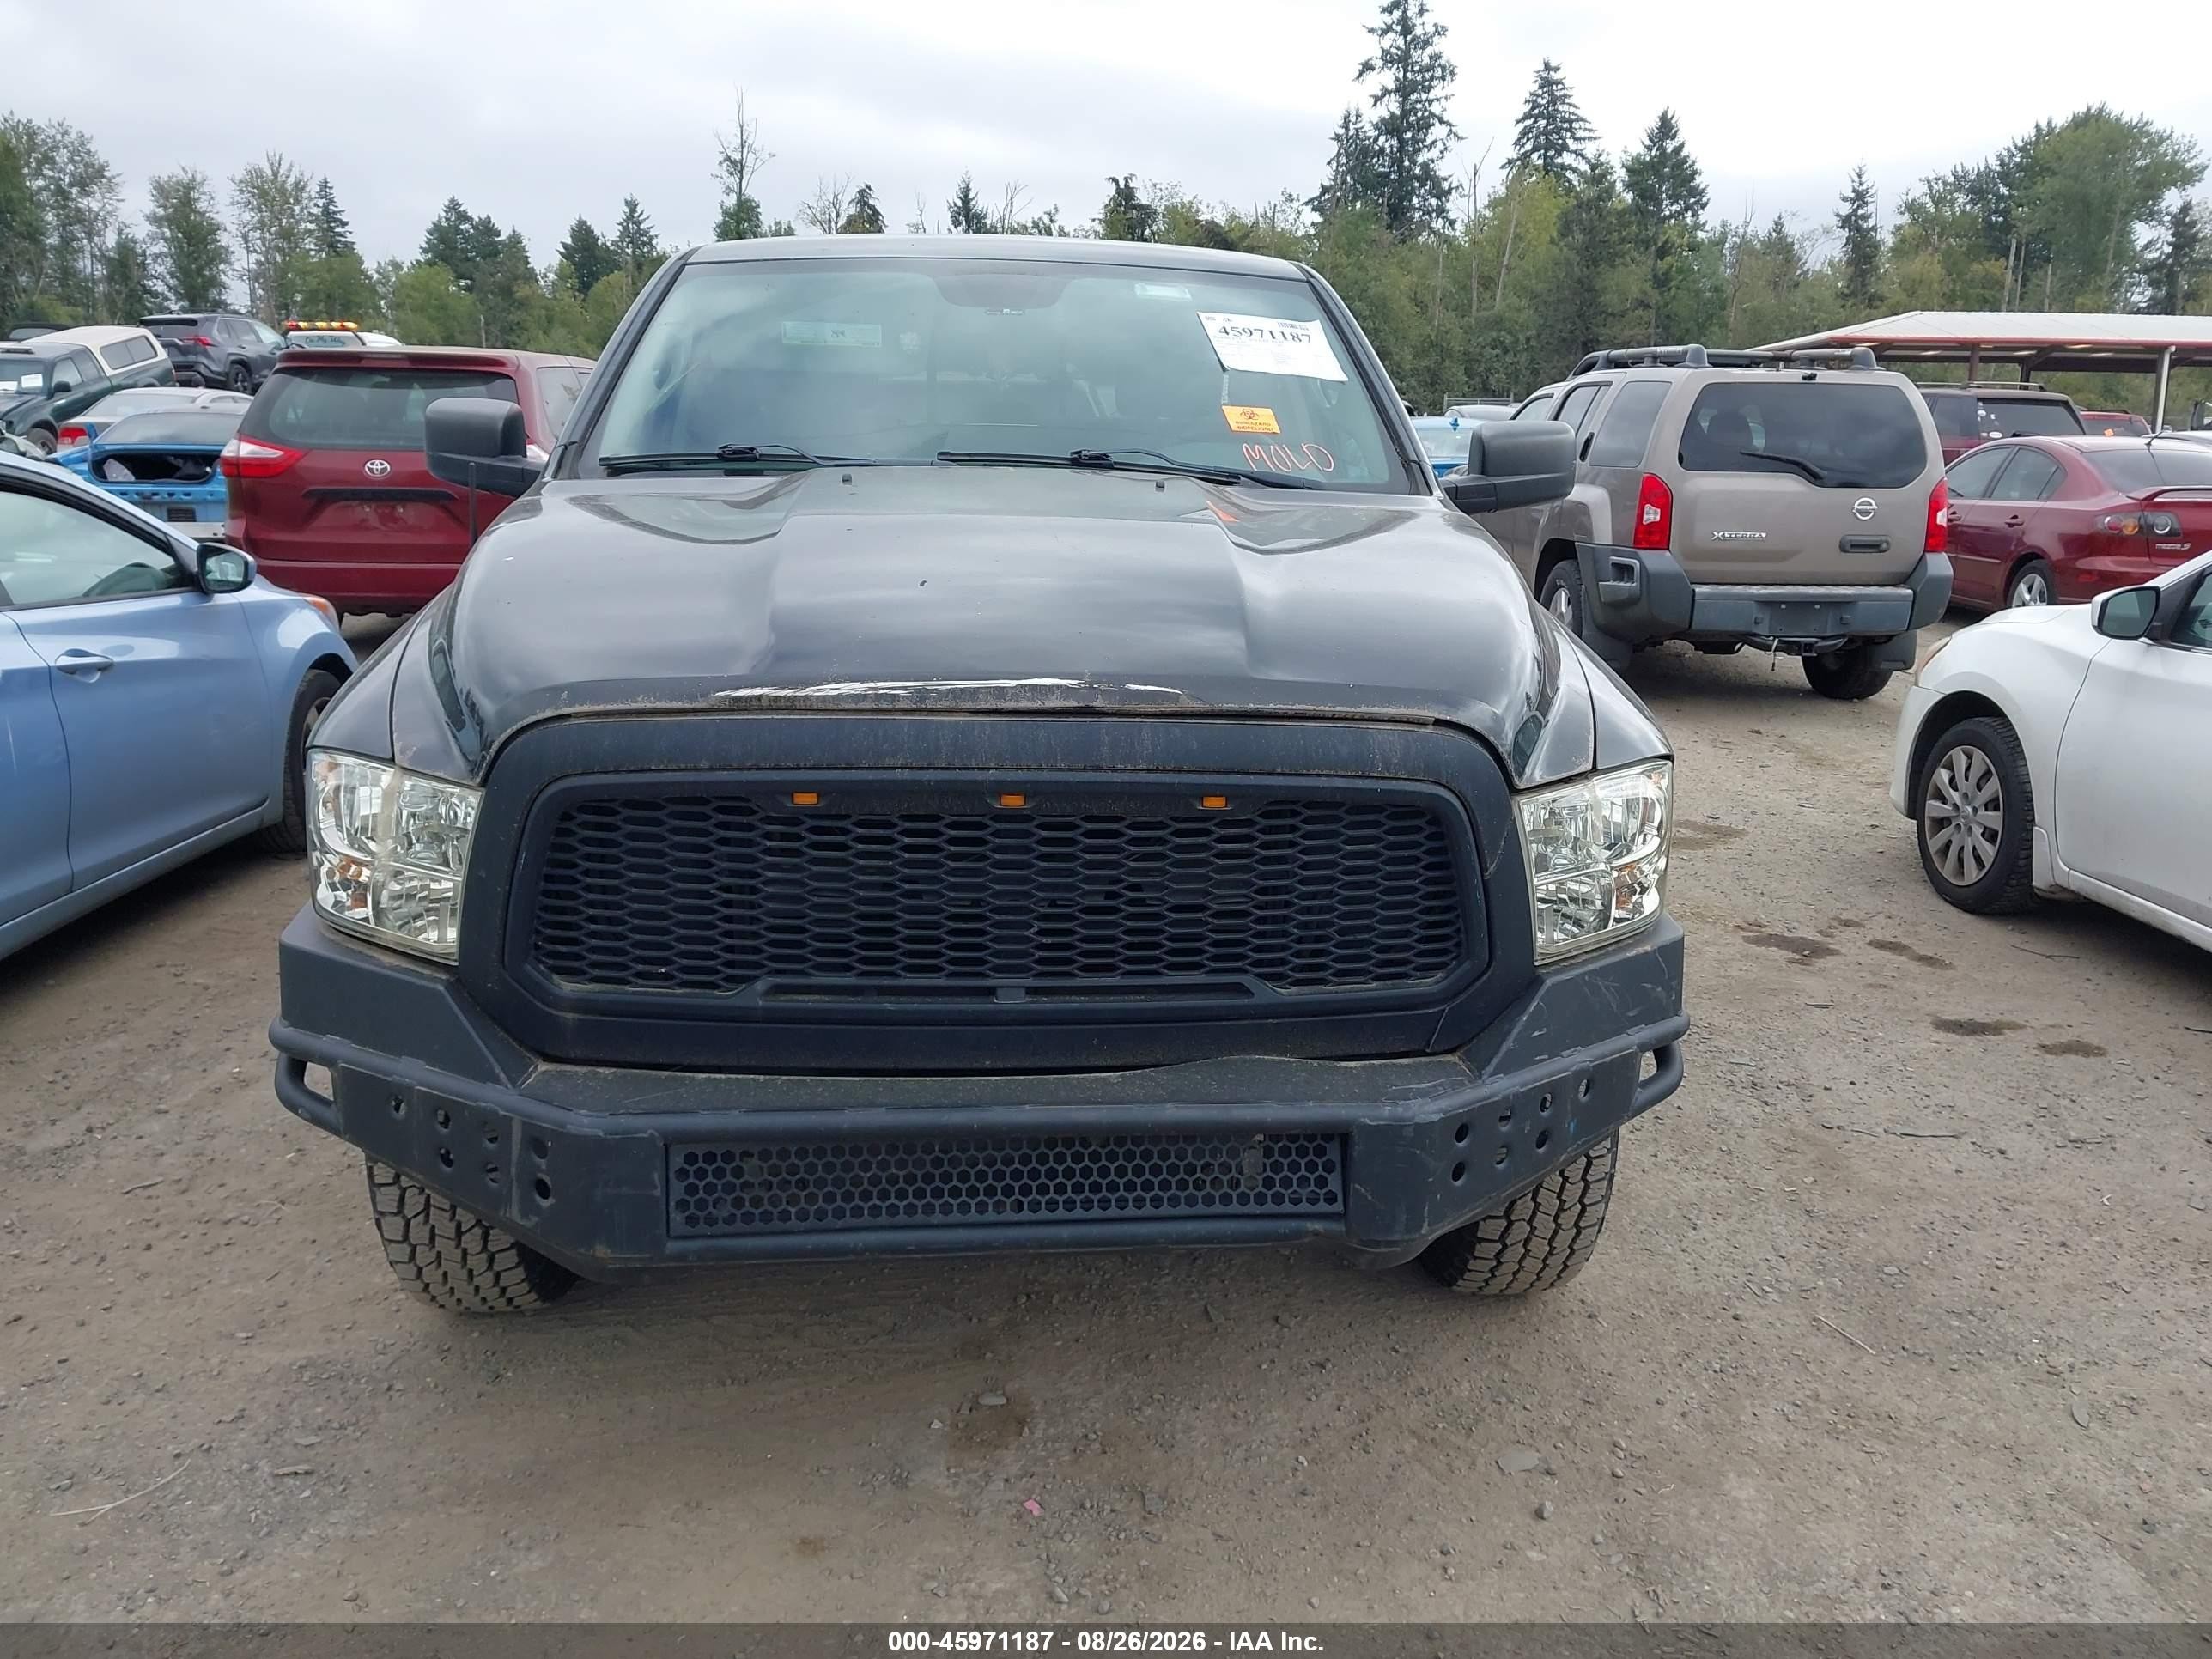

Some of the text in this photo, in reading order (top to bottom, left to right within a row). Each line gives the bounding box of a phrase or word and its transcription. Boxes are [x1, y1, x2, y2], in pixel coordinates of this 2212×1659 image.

[1218, 325, 1311, 343] 45971187
[1243, 442, 1334, 472] MOLD
[1711, 531, 1767, 541] XTERRA
